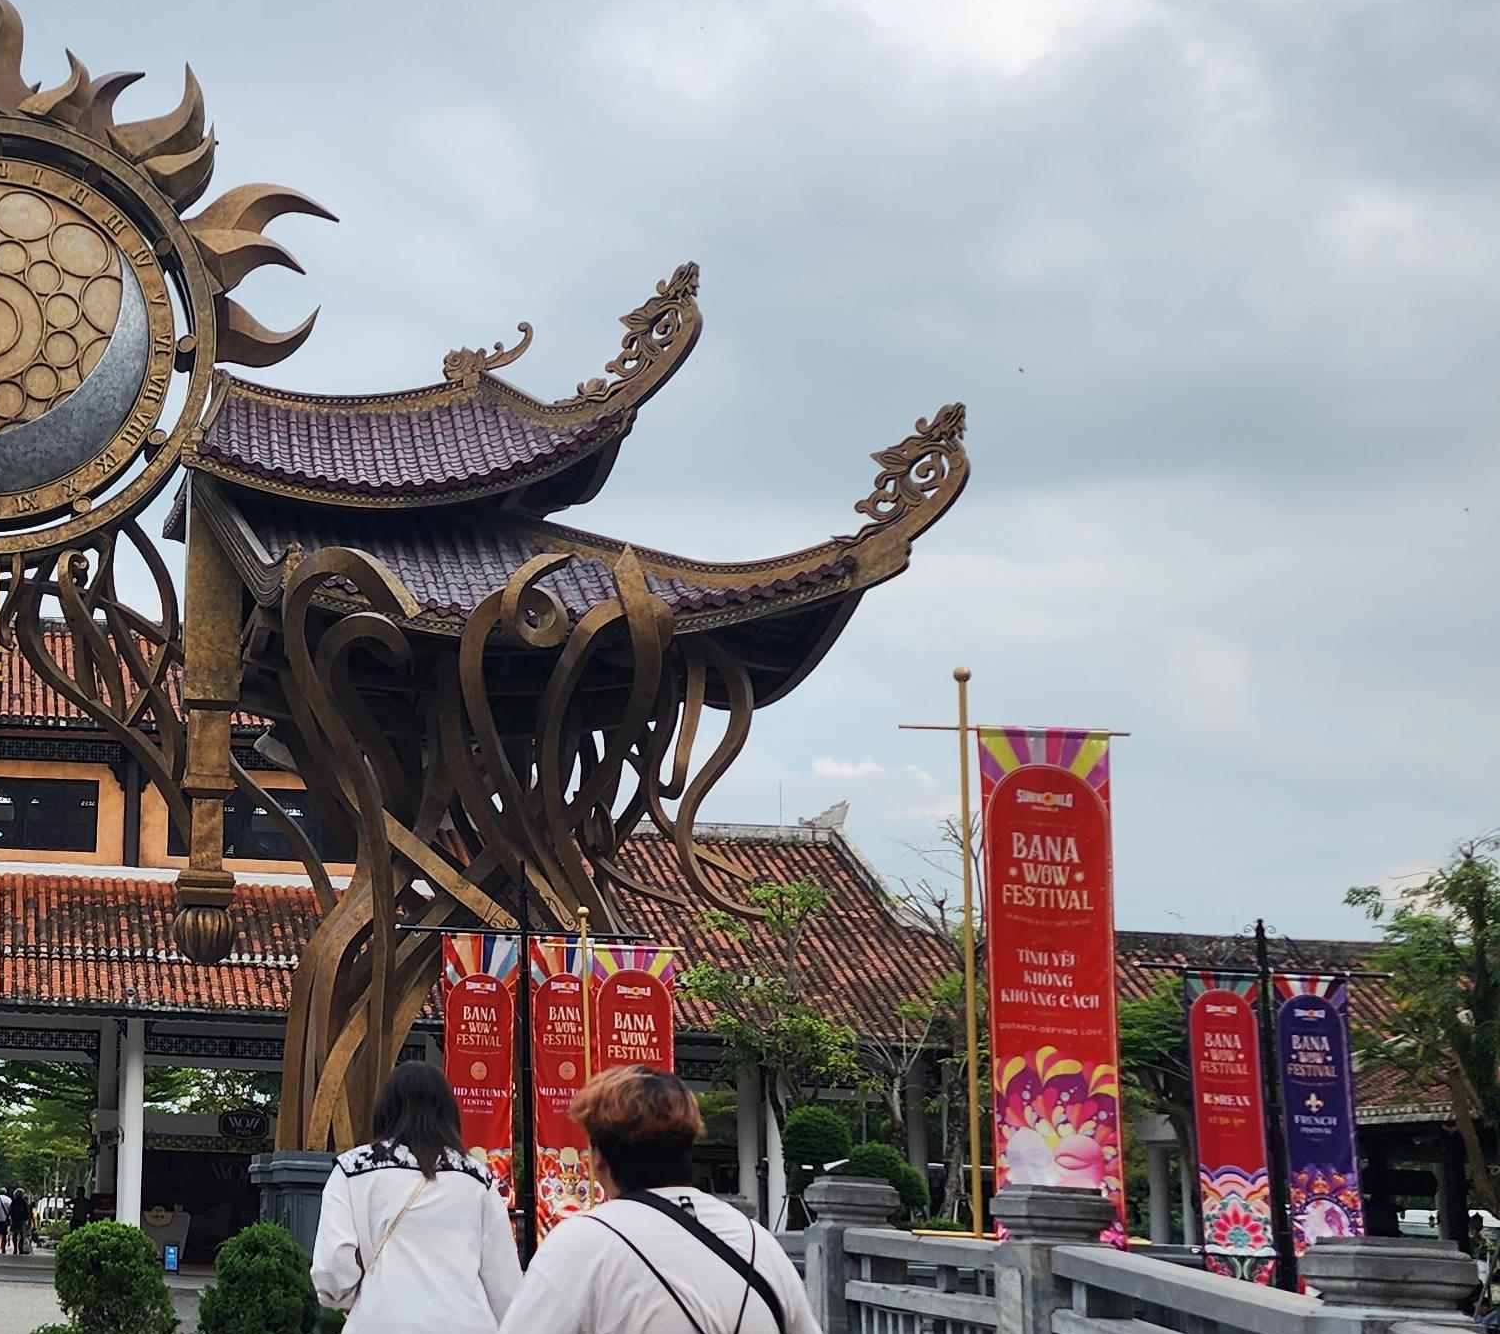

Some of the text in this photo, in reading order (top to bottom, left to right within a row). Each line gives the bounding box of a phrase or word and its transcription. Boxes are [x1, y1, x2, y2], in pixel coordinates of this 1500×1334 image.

[32, 168, 43, 185] I
[70, 185, 89, 206] II
[102, 210, 128, 237] III
[130, 244, 153, 267] IV
[150, 292, 167, 306] V
[155, 332, 171, 355] VI
[144, 372, 167, 404] VII
[120, 411, 152, 446] VIII
[95, 449, 123, 474] IX
[62, 478, 81, 497] X
[14, 493, 40, 513] XI
[1012, 832, 1081, 863] BANA
[1022, 862, 1071, 886] WOW
[1002, 884, 1095, 910] FESTIVAL
[463, 1005, 497, 1022] BANA
[548, 1005, 581, 1022] BANA
[614, 1011, 656, 1031] BANA
[468, 1021, 492, 1034] WOW
[554, 1021, 577, 1034] WOW
[456, 1034, 502, 1047] FESTIVAL
[620, 1031, 650, 1046] WOW
[1204, 1032, 1242, 1048] BANA
[1291, 1034, 1330, 1051] BANA
[607, 1044, 663, 1061] FESTIVAL
[1200, 1061, 1250, 1075] FESTIVAL
[1286, 1063, 1338, 1077] FESTIVAL
[469, 1087, 508, 1098] AUTUMN
[539, 1086, 557, 1096] MID
[1293, 1115, 1337, 1126] FRENCH
